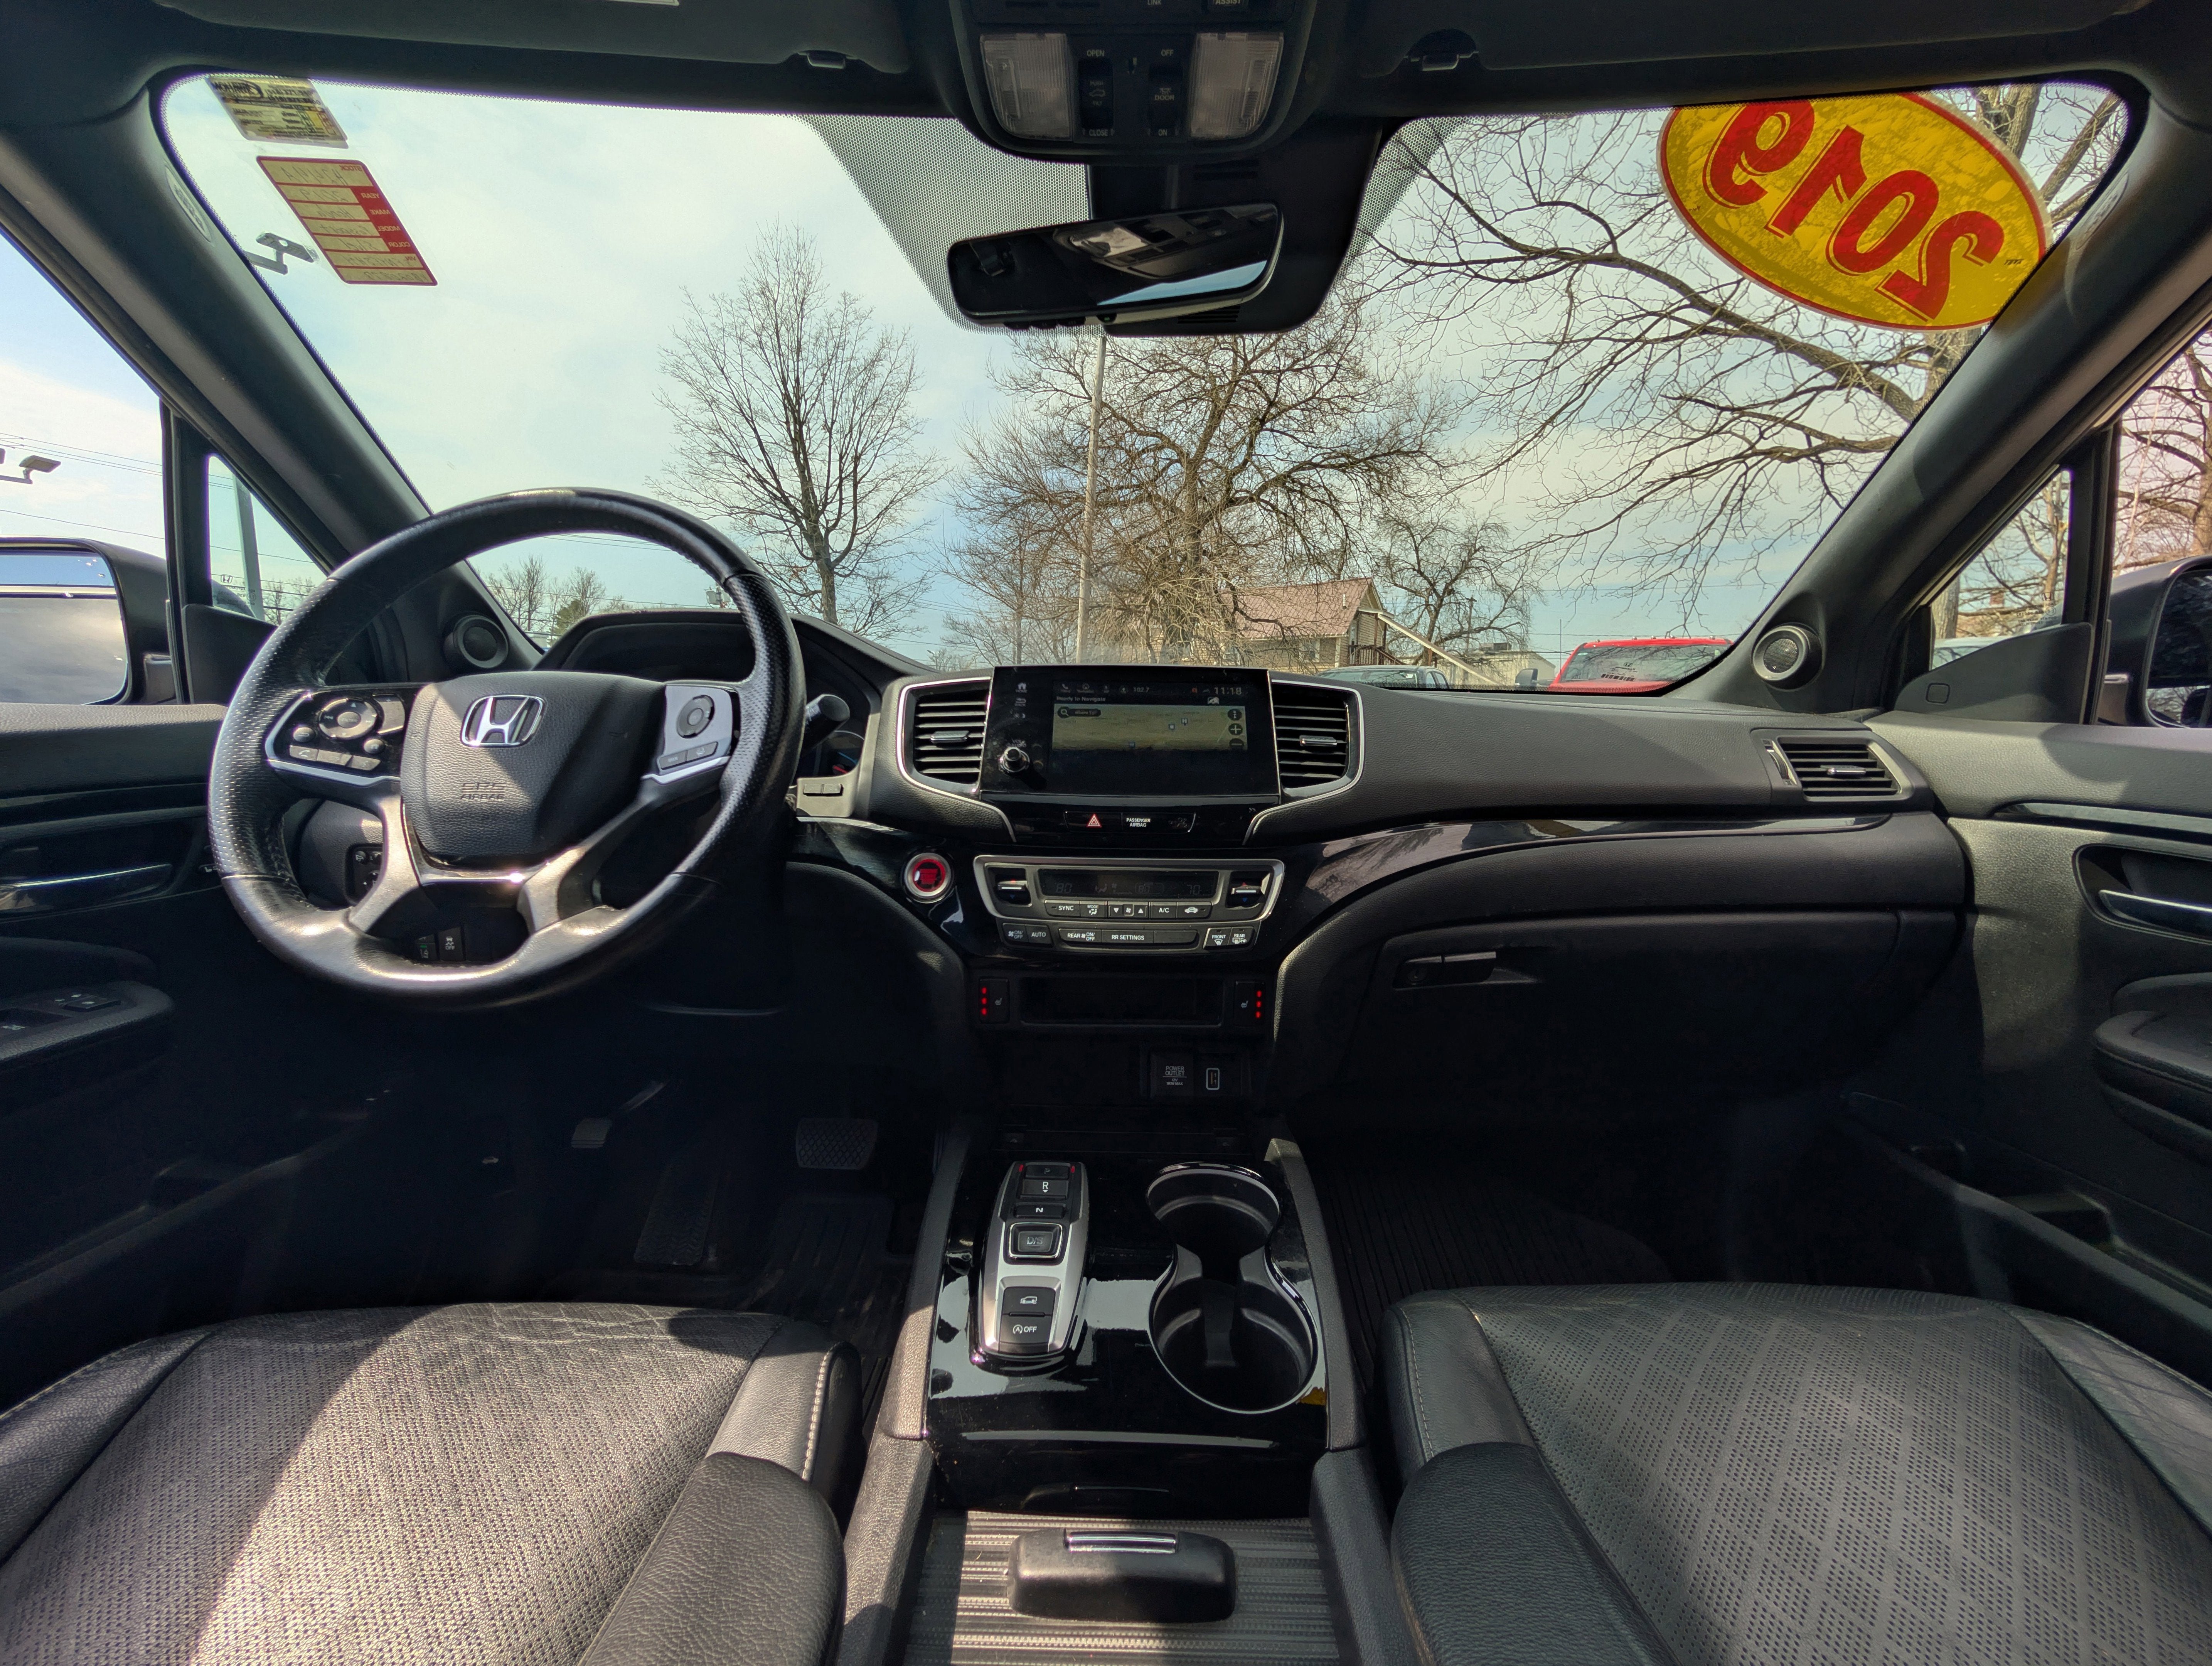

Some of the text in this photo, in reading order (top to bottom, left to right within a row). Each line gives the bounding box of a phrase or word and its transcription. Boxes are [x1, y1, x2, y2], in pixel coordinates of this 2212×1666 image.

[1214, 687, 1242, 695] 11:18
[1042, 1181, 1049, 1190] R
[1026, 1236, 1044, 1245] D/S
